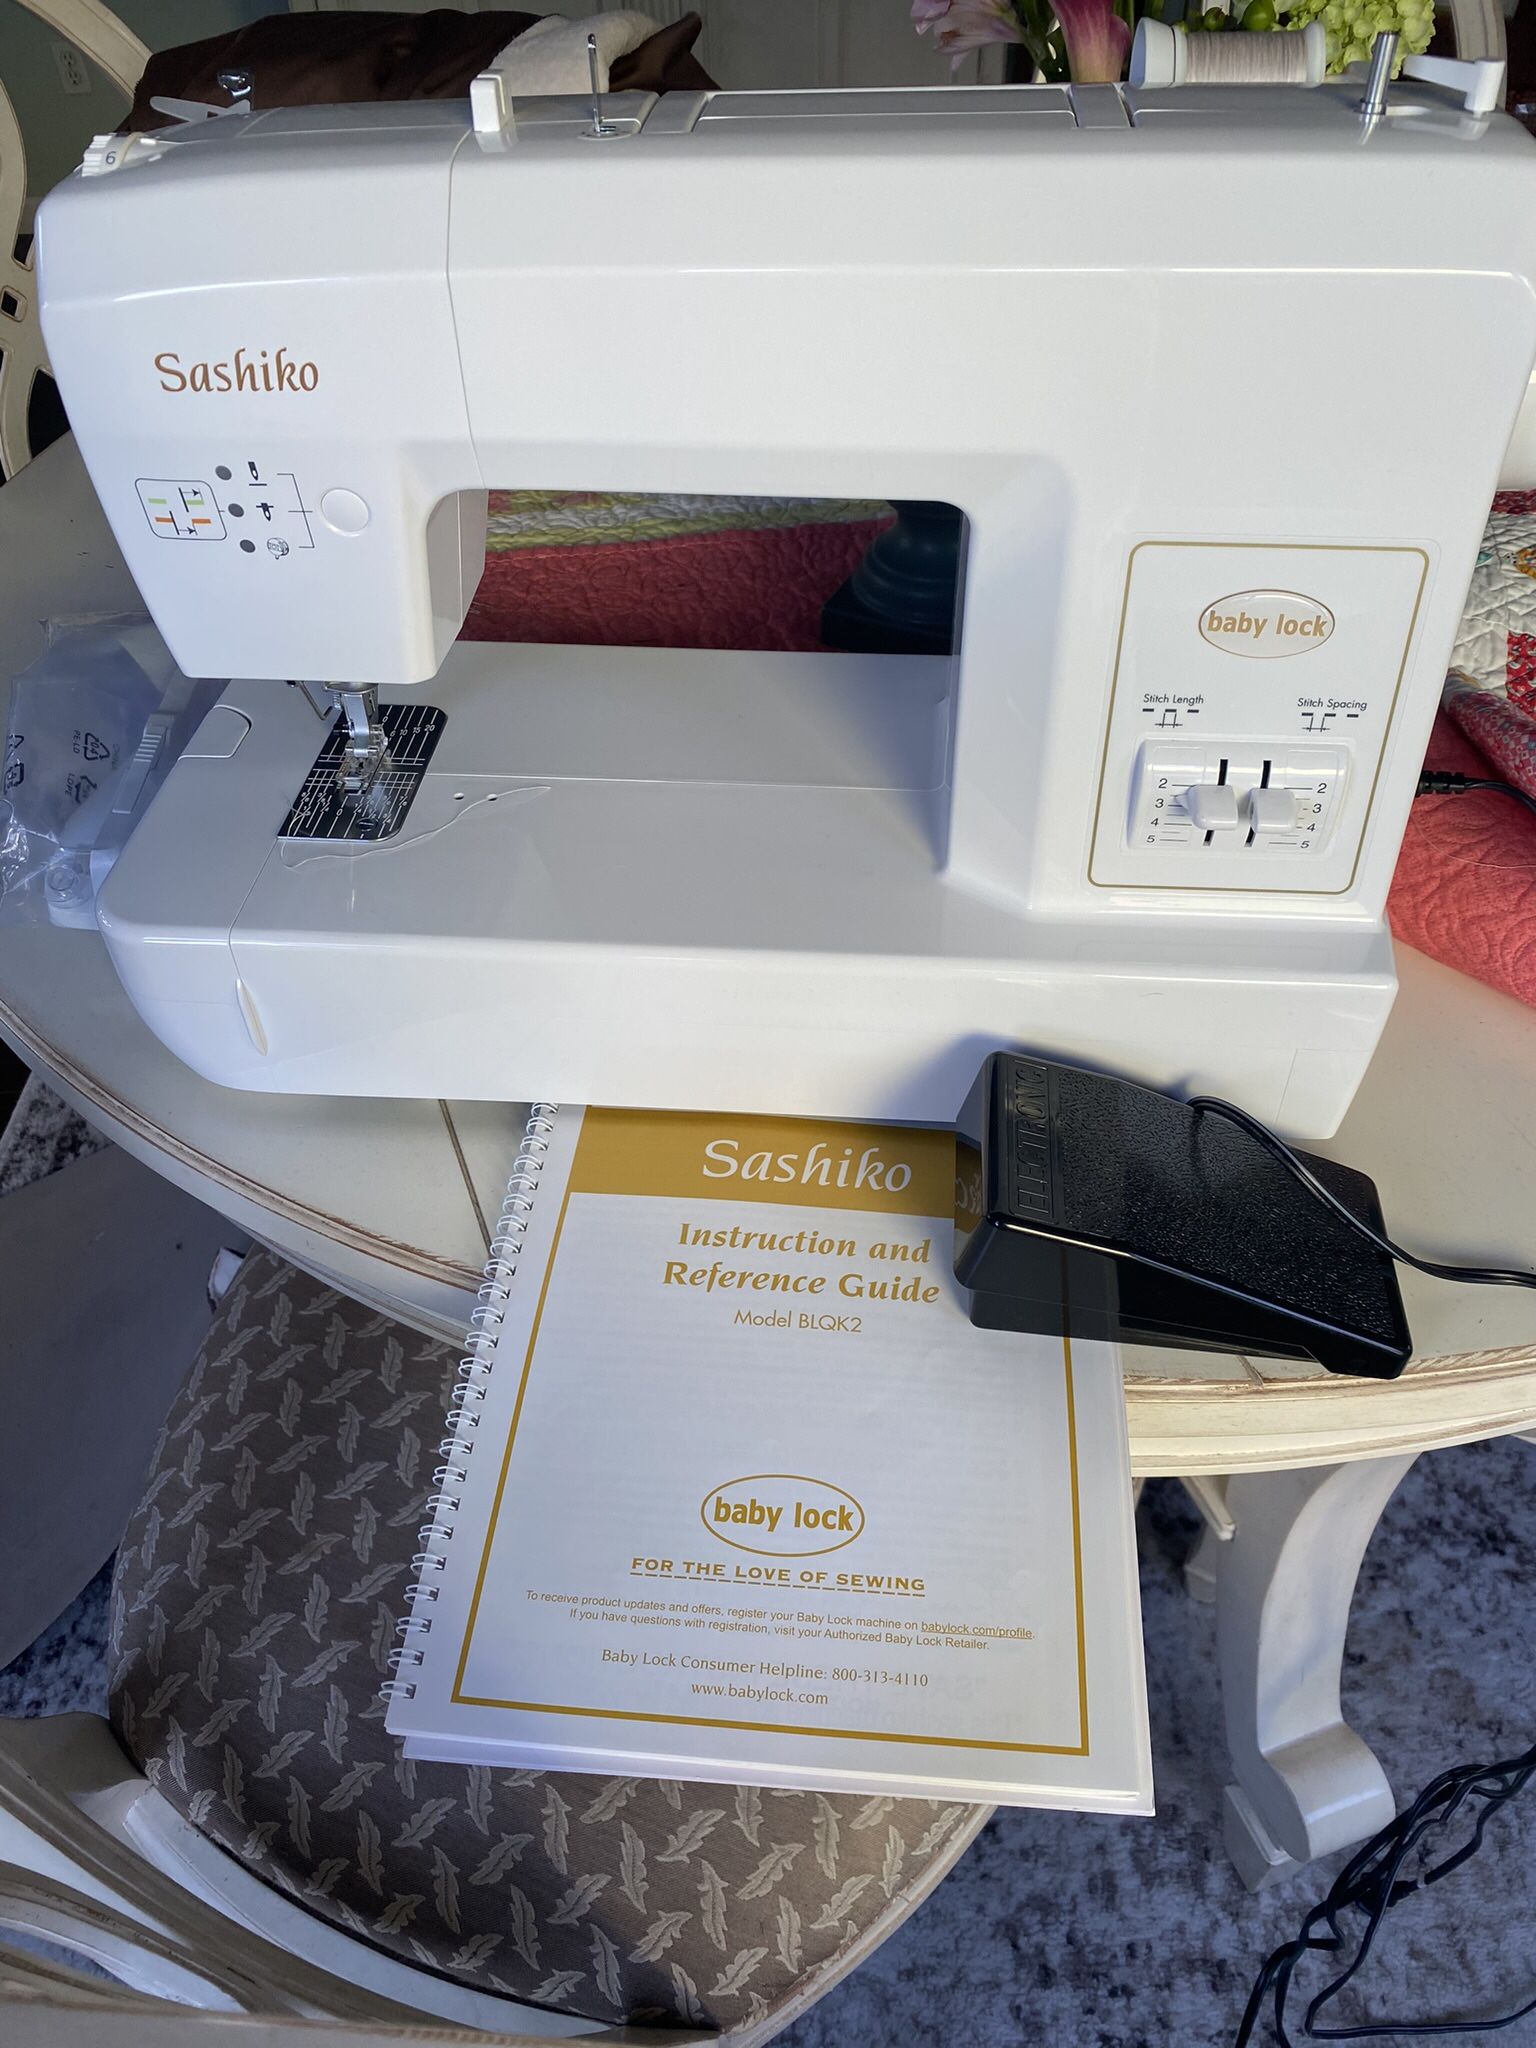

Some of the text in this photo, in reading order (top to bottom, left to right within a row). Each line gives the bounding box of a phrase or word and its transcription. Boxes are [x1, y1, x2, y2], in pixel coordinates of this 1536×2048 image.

[105, 150, 117, 165] 6
[153, 346, 319, 393] Sashiko
[1207, 609, 1328, 639] baby lock
[1143, 693, 1204, 707] Stitch Length
[1297, 697, 1368, 712] Stitch Spacing
[400, 728, 409, 736] 10
[412, 726, 422, 734] 15
[424, 724, 436, 732] 20
[1158, 778, 1168, 789] 2
[1317, 783, 1327, 794] 2
[336, 808, 343, 816] 0
[1155, 799, 1164, 808] 3
[1312, 804, 1322, 814] 3
[1150, 818, 1159, 827] 4
[1306, 823, 1316, 832] 4
[1146, 835, 1156, 844] 5
[1300, 841, 1310, 849] 5
[1015, 1067, 1049, 1214] ELECTRONIC
[702, 1139, 912, 1192] Sashiko
[678, 1222, 932, 1263] Instruction and
[663, 1261, 940, 1303] Reference Guide
[734, 1309, 863, 1333] Model BLQK2
[713, 1496, 854, 1533] baby lock
[631, 1557, 926, 1591] FOR THE LOVE OF SEWING
[526, 1590, 1036, 1640] To receive product updates and offers, register your Baby Lock machine on babylock.com/profile.
[570, 1608, 990, 1650] If you have questions with registration, visit your Authorized Baby Lock Retailer.
[602, 1649, 638, 1667] Baby
[643, 1652, 677, 1668] Lock
[681, 1655, 756, 1674] Consumer
[759, 1662, 828, 1680] Helpline:
[831, 1667, 929, 1687] 800-313-4110
[691, 1681, 829, 1705] www.babylock.com
